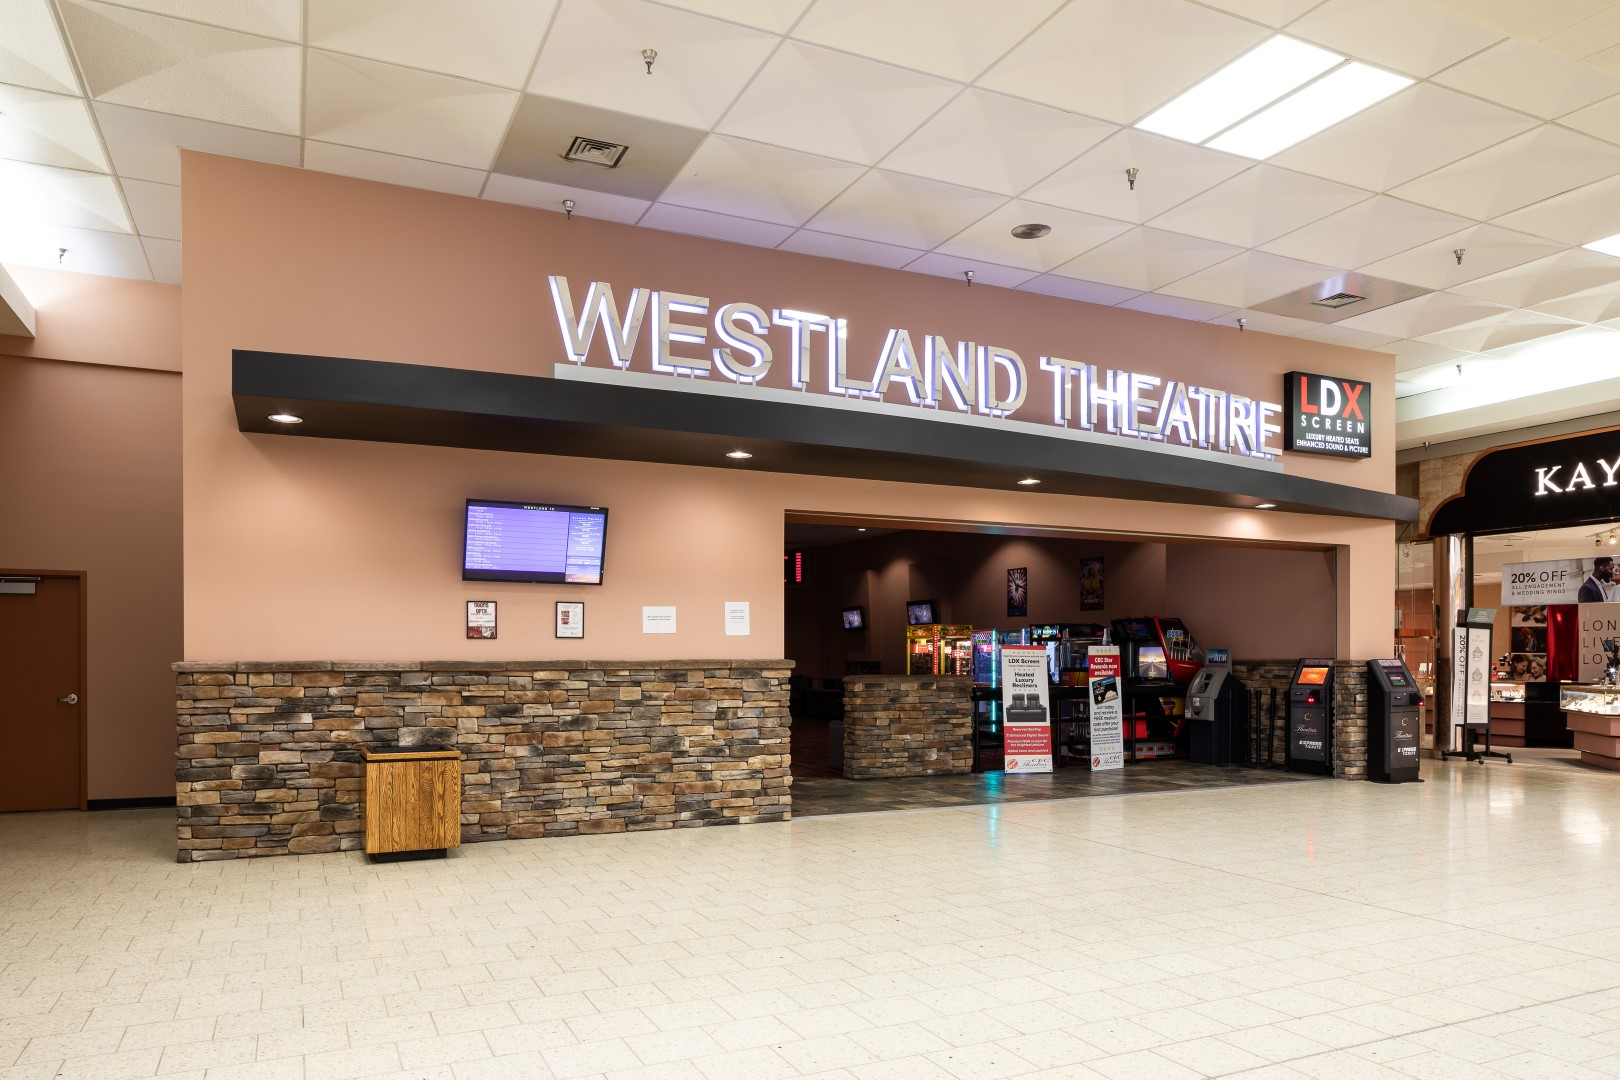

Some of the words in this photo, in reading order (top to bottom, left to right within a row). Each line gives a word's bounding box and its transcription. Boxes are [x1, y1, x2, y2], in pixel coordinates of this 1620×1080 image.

[547, 274, 1028, 416] WESTLAND
[1039, 356, 1284, 458] THEATRE
[1300, 376, 1364, 420] LDX
[1301, 414, 1365, 434] SCREEN
[1306, 432, 1325, 442] LUXURY
[1326, 434, 1344, 444] HEATED
[1296, 440, 1325, 448] ENHANCED
[1326, 442, 1343, 450] SOUND
[1349, 445, 1368, 454] PICTURE
[1534, 456, 1620, 496] KAY
[1511, 572, 1536, 584] 20%
[1540, 570, 1568, 582] OFF
[1582, 620, 1617, 631] LON
[1166, 630, 1184, 638] SEGA
[1214, 654, 1227, 662] ATM
[1582, 653, 1610, 664] LO
